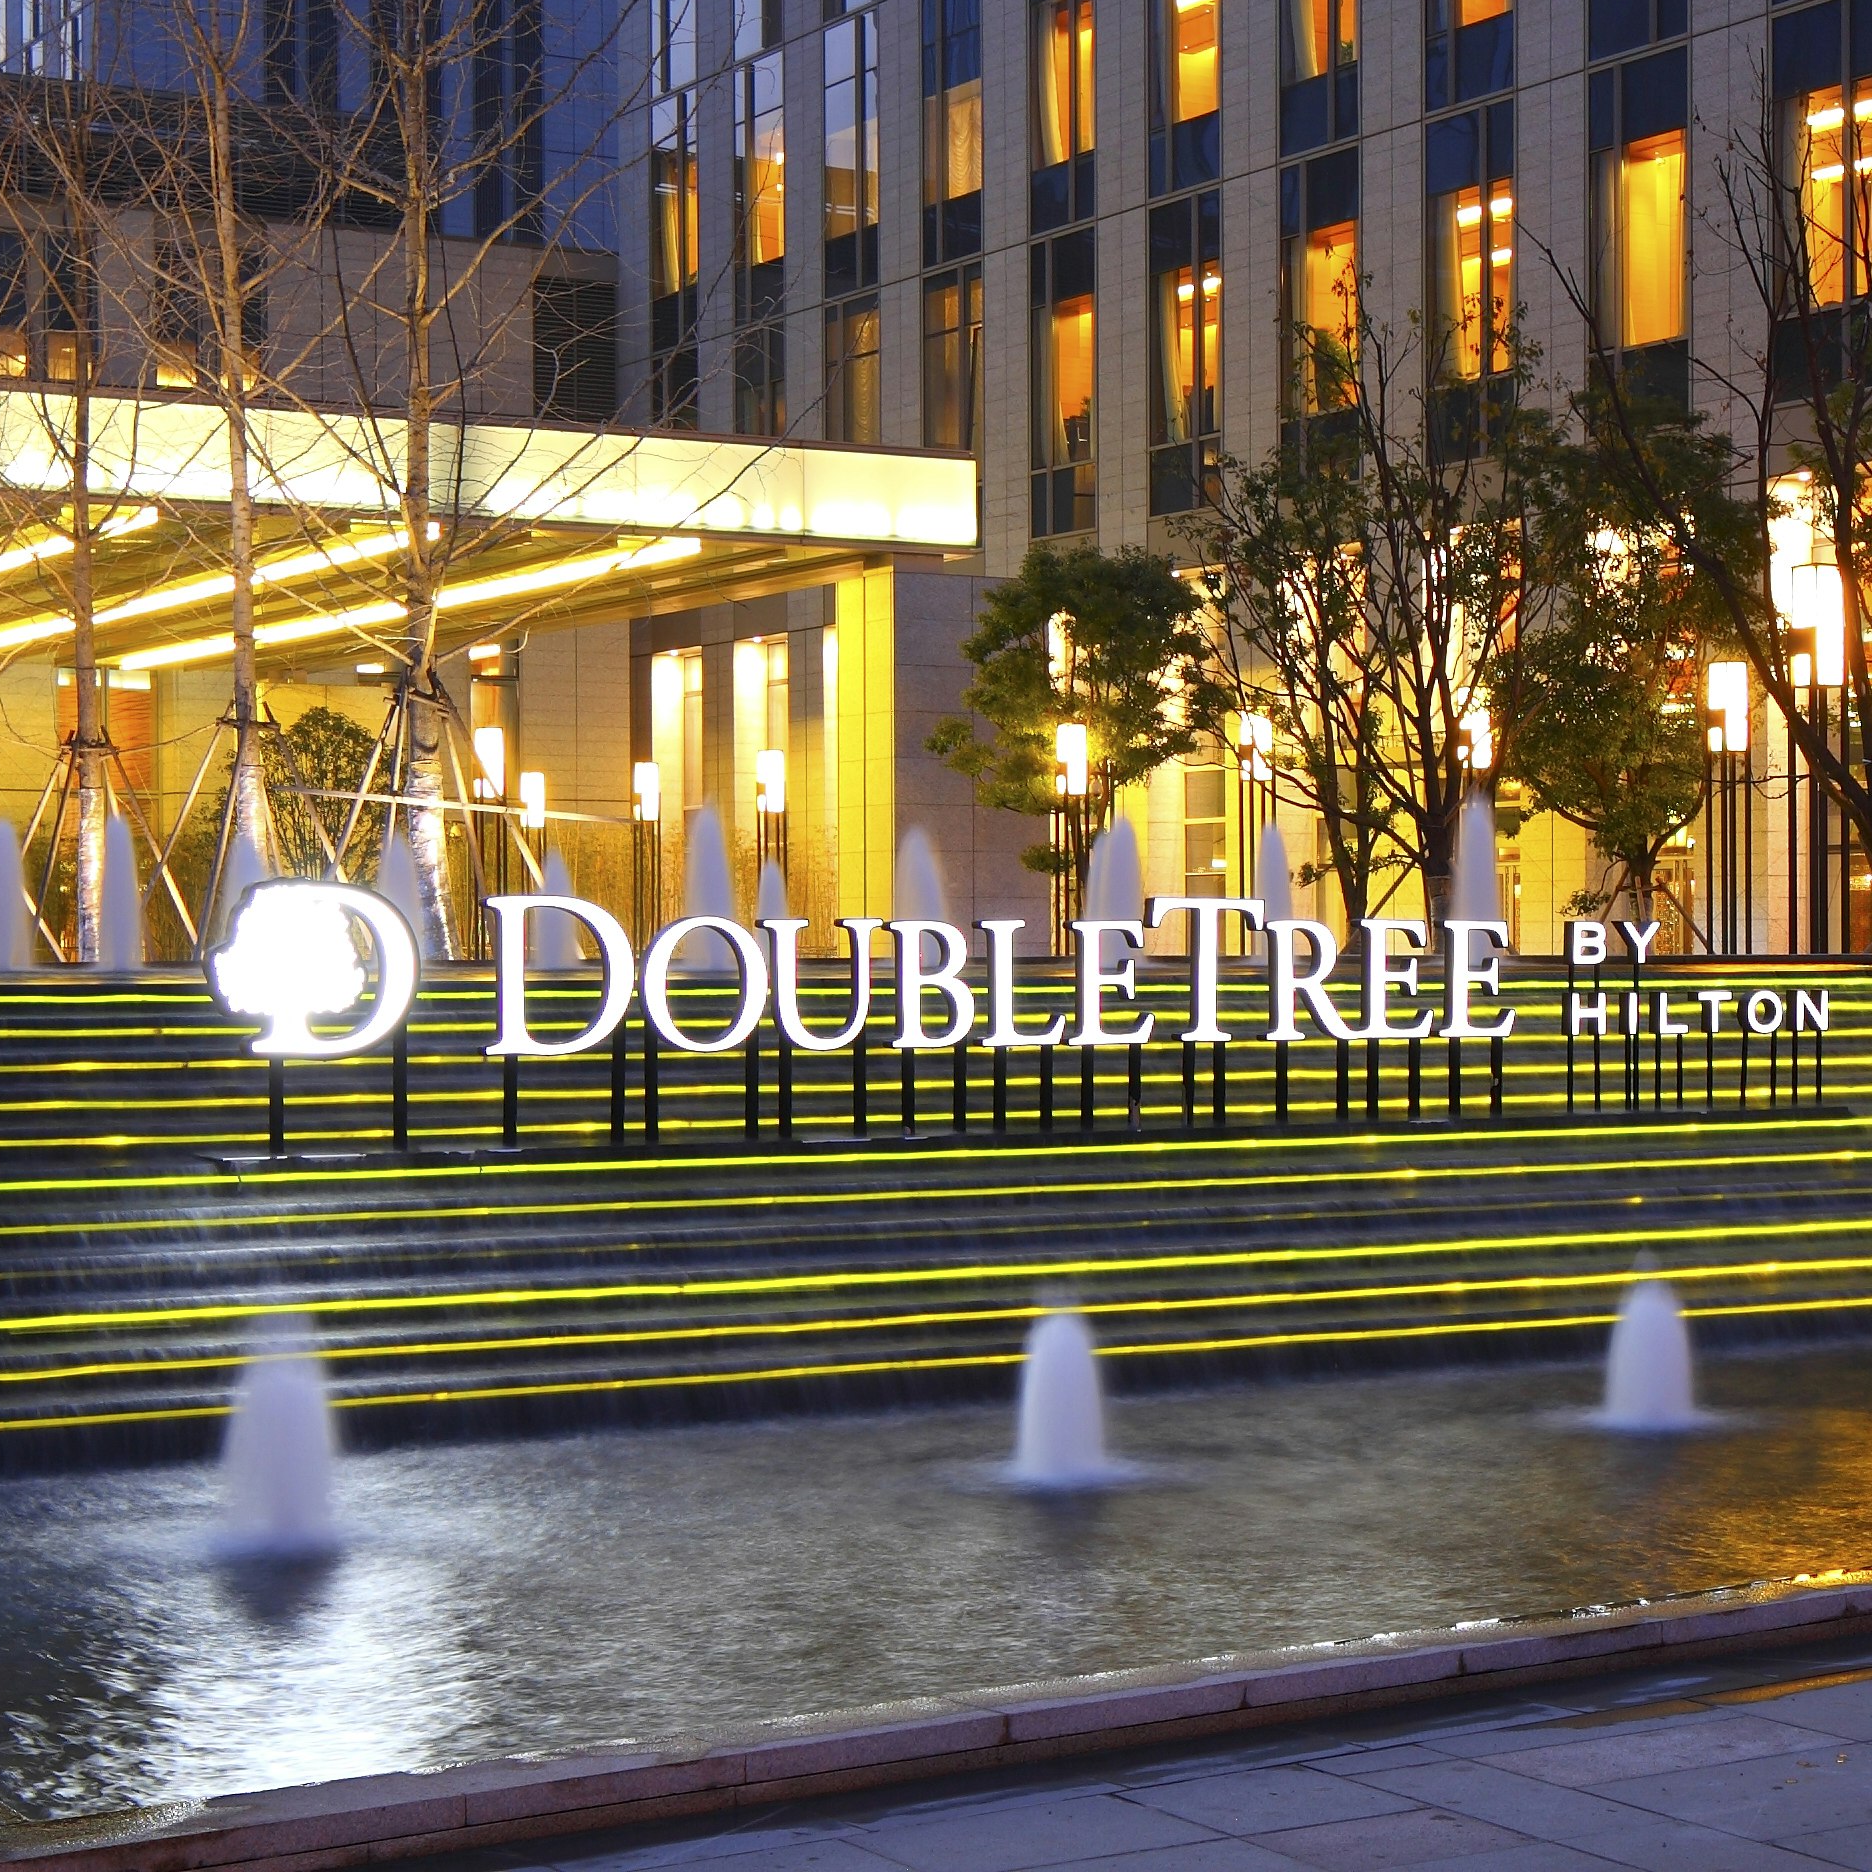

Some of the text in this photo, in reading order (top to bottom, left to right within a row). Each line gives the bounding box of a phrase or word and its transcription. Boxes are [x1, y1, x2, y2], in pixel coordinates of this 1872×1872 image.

[1571, 921, 1662, 965] BY
[484, 894, 1517, 1056] DOUBLETREE
[1571, 990, 1830, 1036] HILTON
